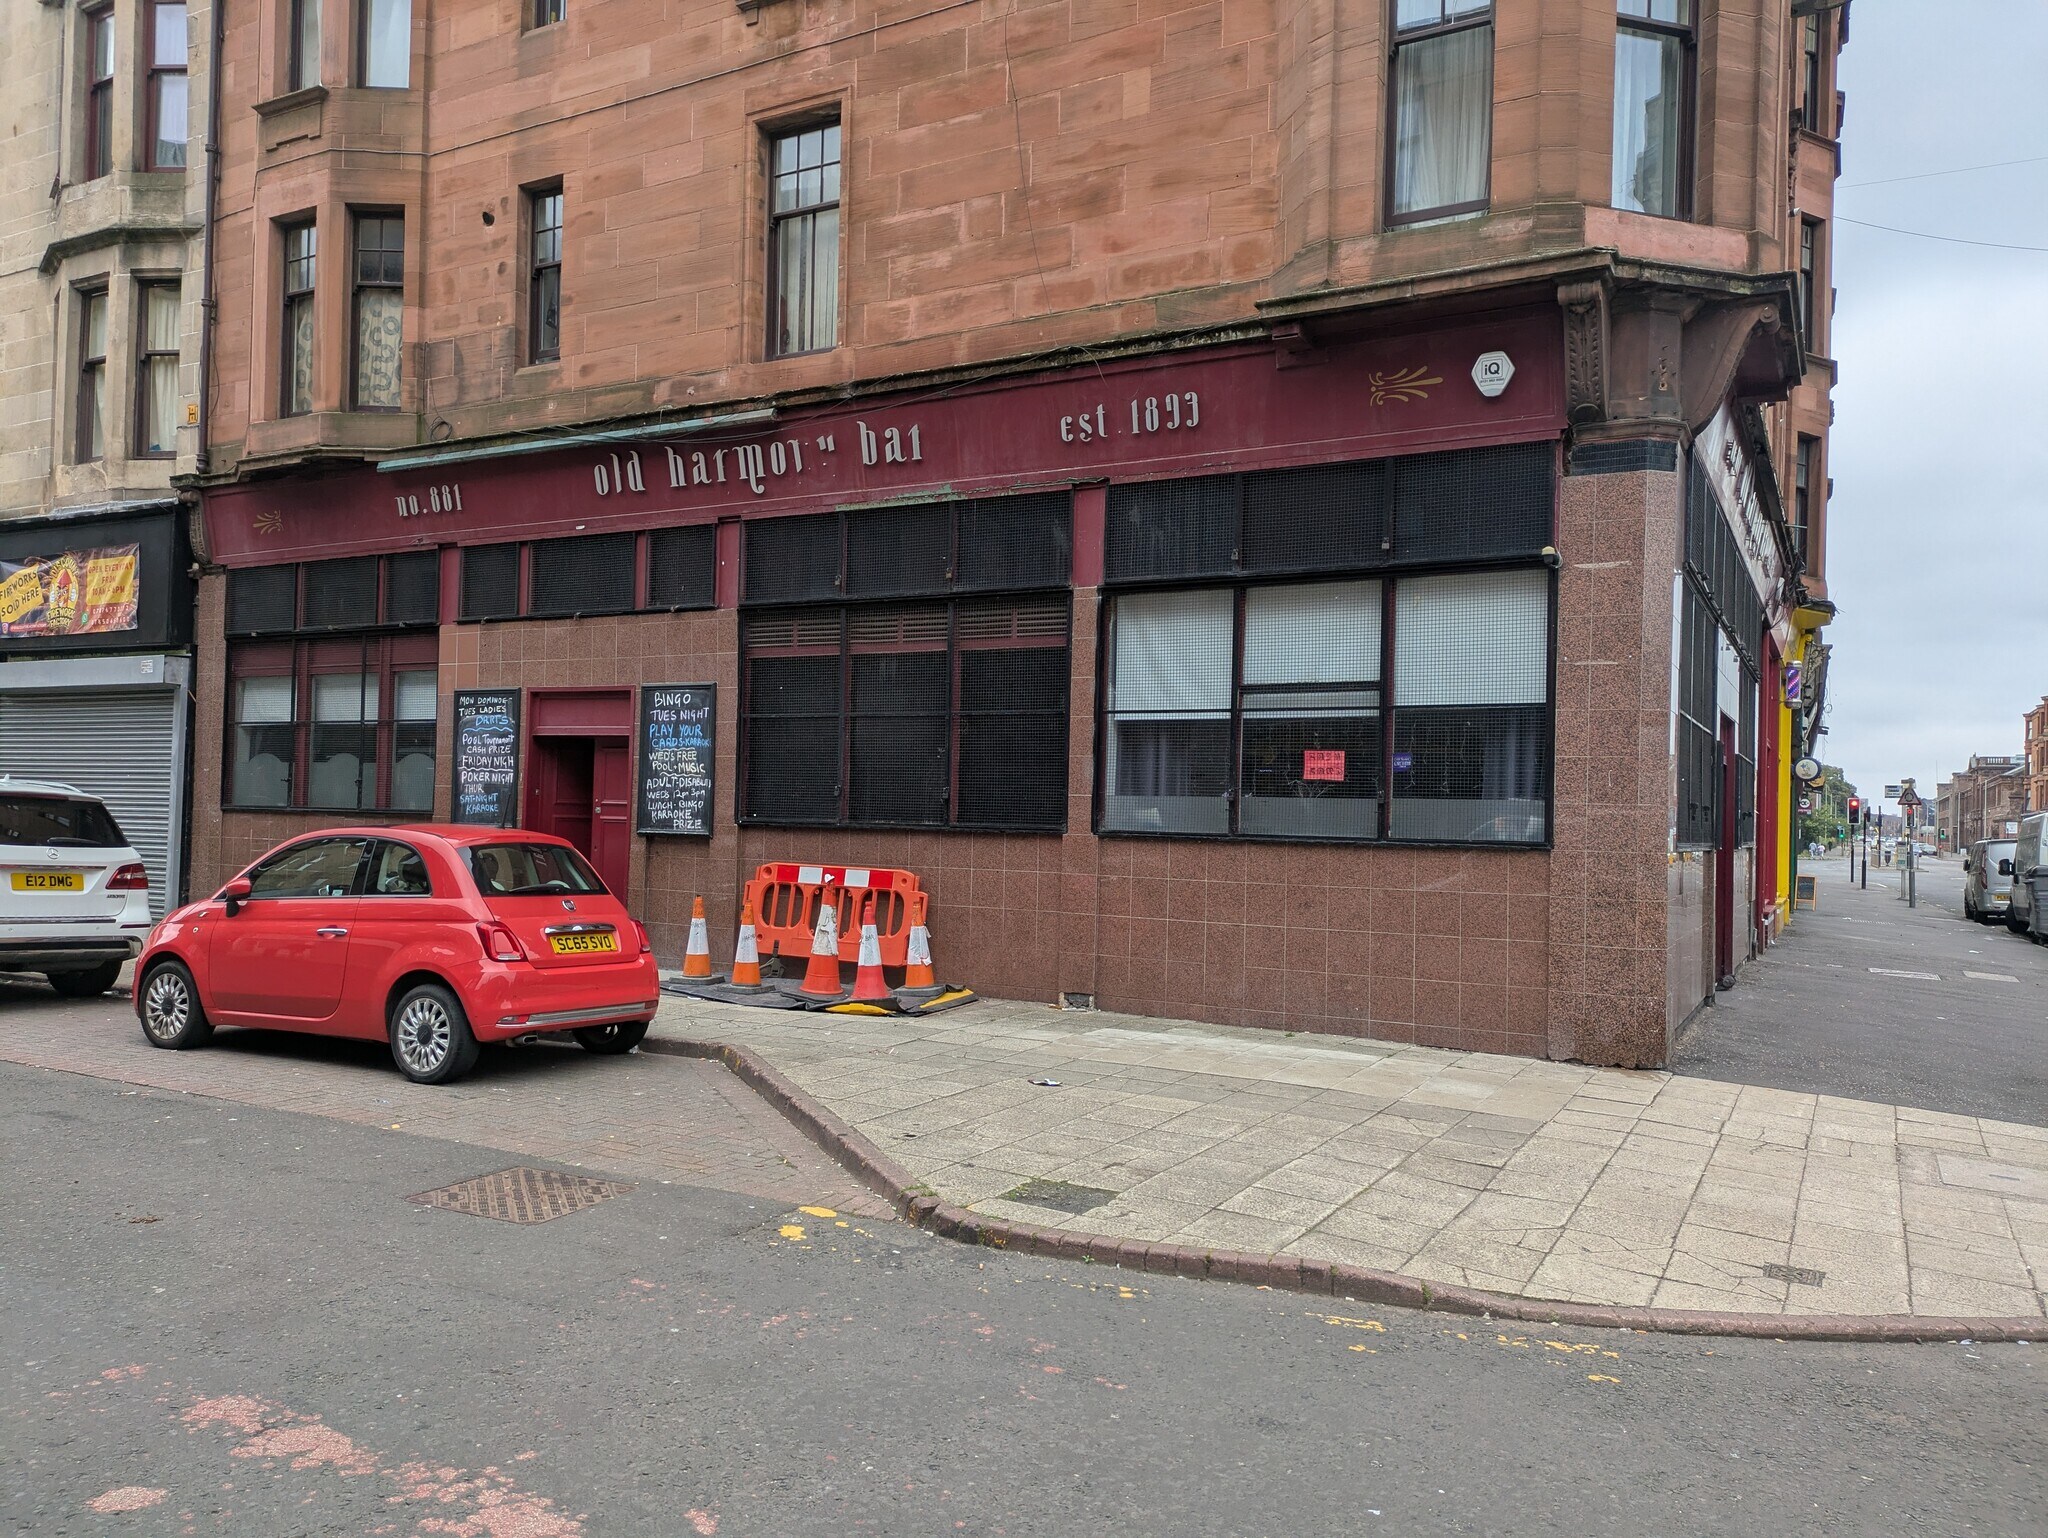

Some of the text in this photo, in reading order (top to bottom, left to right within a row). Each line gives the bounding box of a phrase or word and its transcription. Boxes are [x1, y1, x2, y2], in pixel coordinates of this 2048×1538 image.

[1484, 362, 1500, 375] iQ
[1131, 391, 1199, 434] 1893
[594, 450, 646, 495] old
[1, 586, 39, 617] SOLD HERE
[460, 696, 474, 706] MON
[654, 692, 691, 708] BINGO
[459, 705, 507, 717] TUES LADIES
[650, 707, 710, 722] TUES NIGHT
[476, 715, 509, 727] DARTS
[649, 723, 703, 738] PLAY YOUR
[467, 745, 511, 754] CASH PRIZE
[677, 750, 698, 762] FREE
[463, 755, 492, 768] FRIDAY
[652, 760, 673, 771] POOL
[678, 762, 706, 773] MUSIC
[462, 771, 514, 784] POKER NIGHT
[464, 783, 485, 794] THUR
[466, 803, 499, 815] KARAOKE
[678, 799, 704, 812] BINGO
[651, 809, 692, 823] KARAOKE
[673, 819, 702, 831] PRIZE
[25, 875, 73, 887] E12 DMG
[557, 936, 589, 951] SC65
